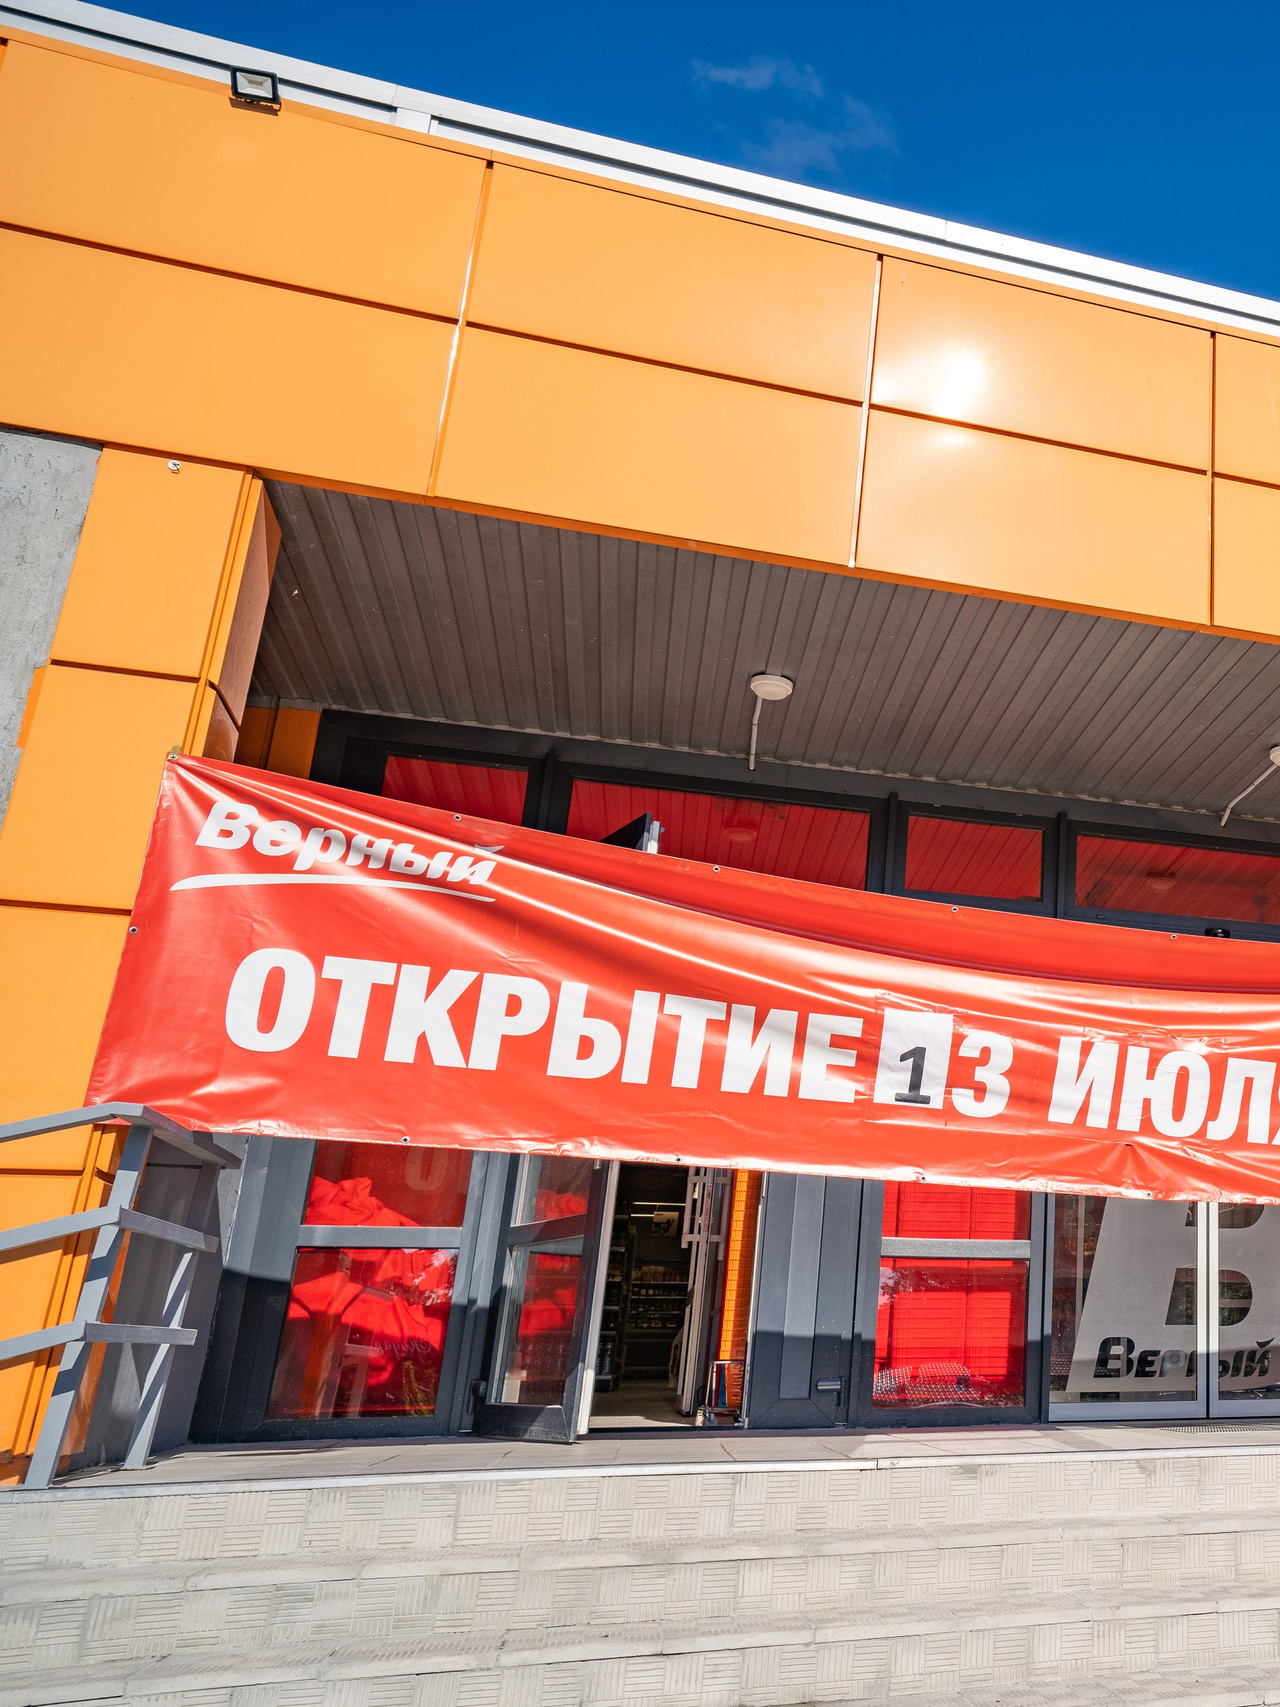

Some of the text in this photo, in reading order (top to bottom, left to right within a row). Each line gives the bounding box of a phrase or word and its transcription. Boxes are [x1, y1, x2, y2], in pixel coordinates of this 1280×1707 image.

[194, 800, 505, 885] Верный
[225, 947, 864, 1104] ОТКРЫТИЕ
[894, 1032, 1014, 1118] 13
